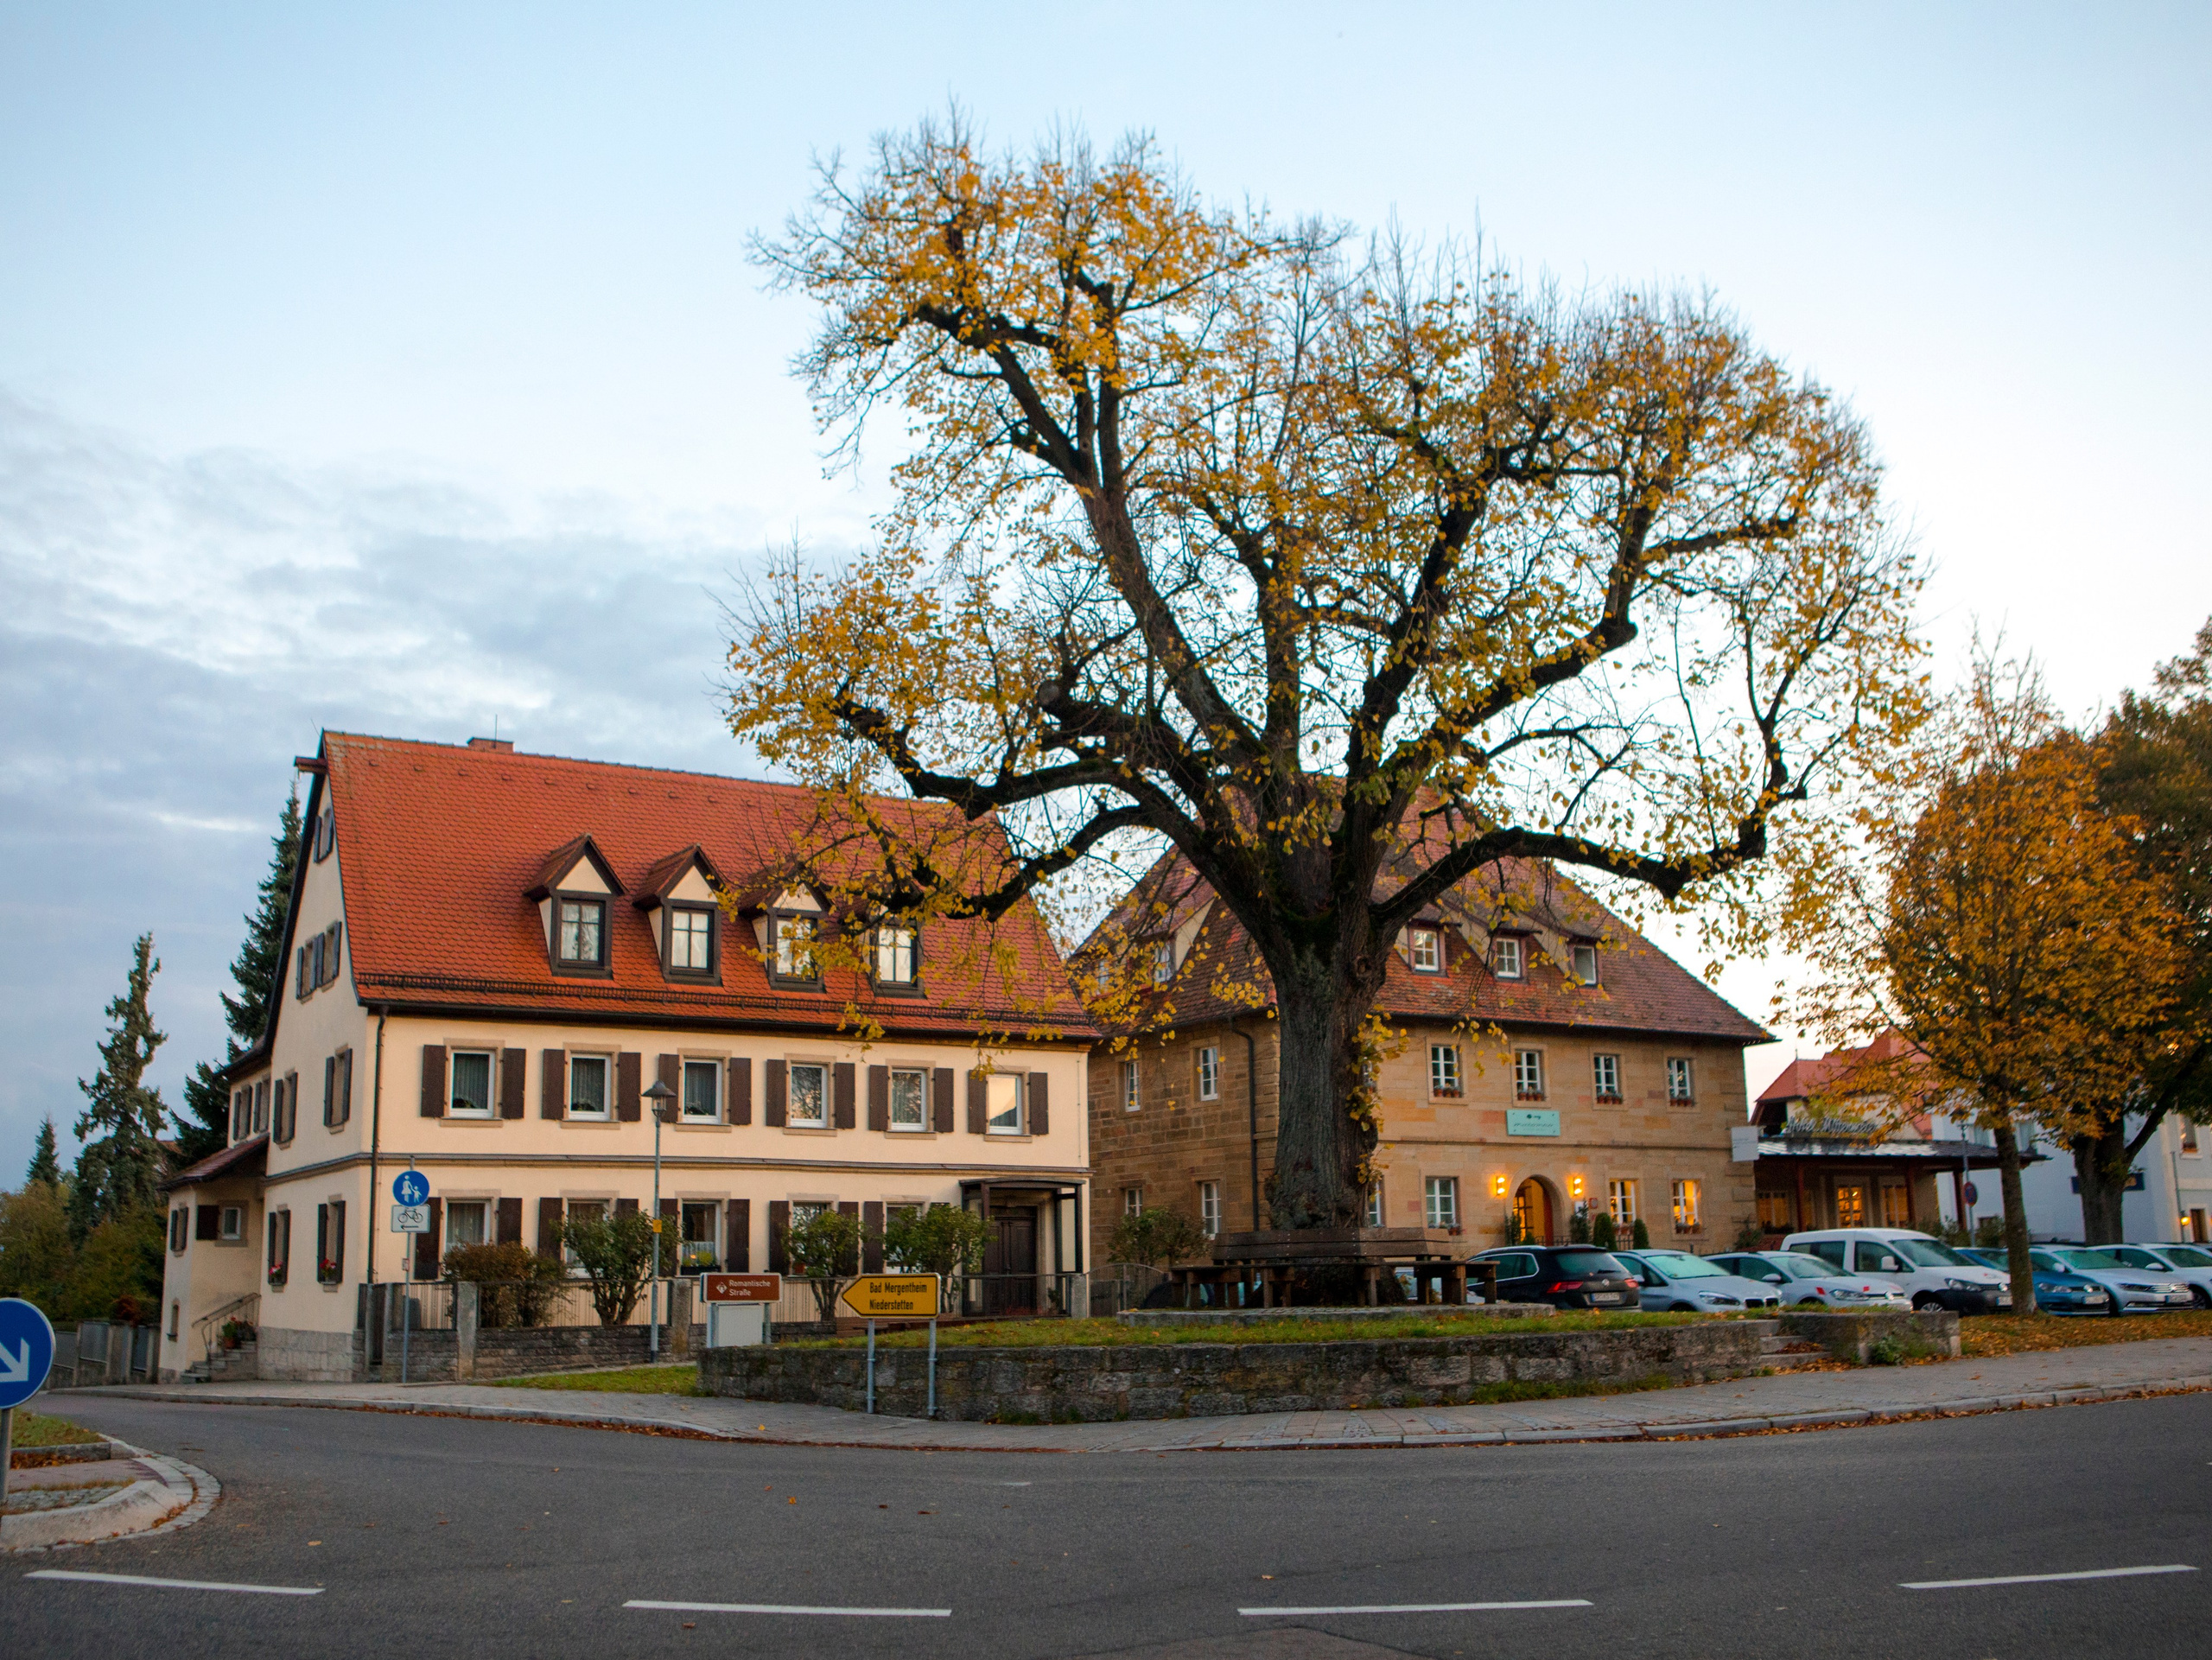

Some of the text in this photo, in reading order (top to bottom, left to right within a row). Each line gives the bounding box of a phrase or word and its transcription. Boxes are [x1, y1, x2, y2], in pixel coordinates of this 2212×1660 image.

[870, 1282, 927, 1295] Bad Mergentheim
[870, 1300, 913, 1310] Niederstetten
